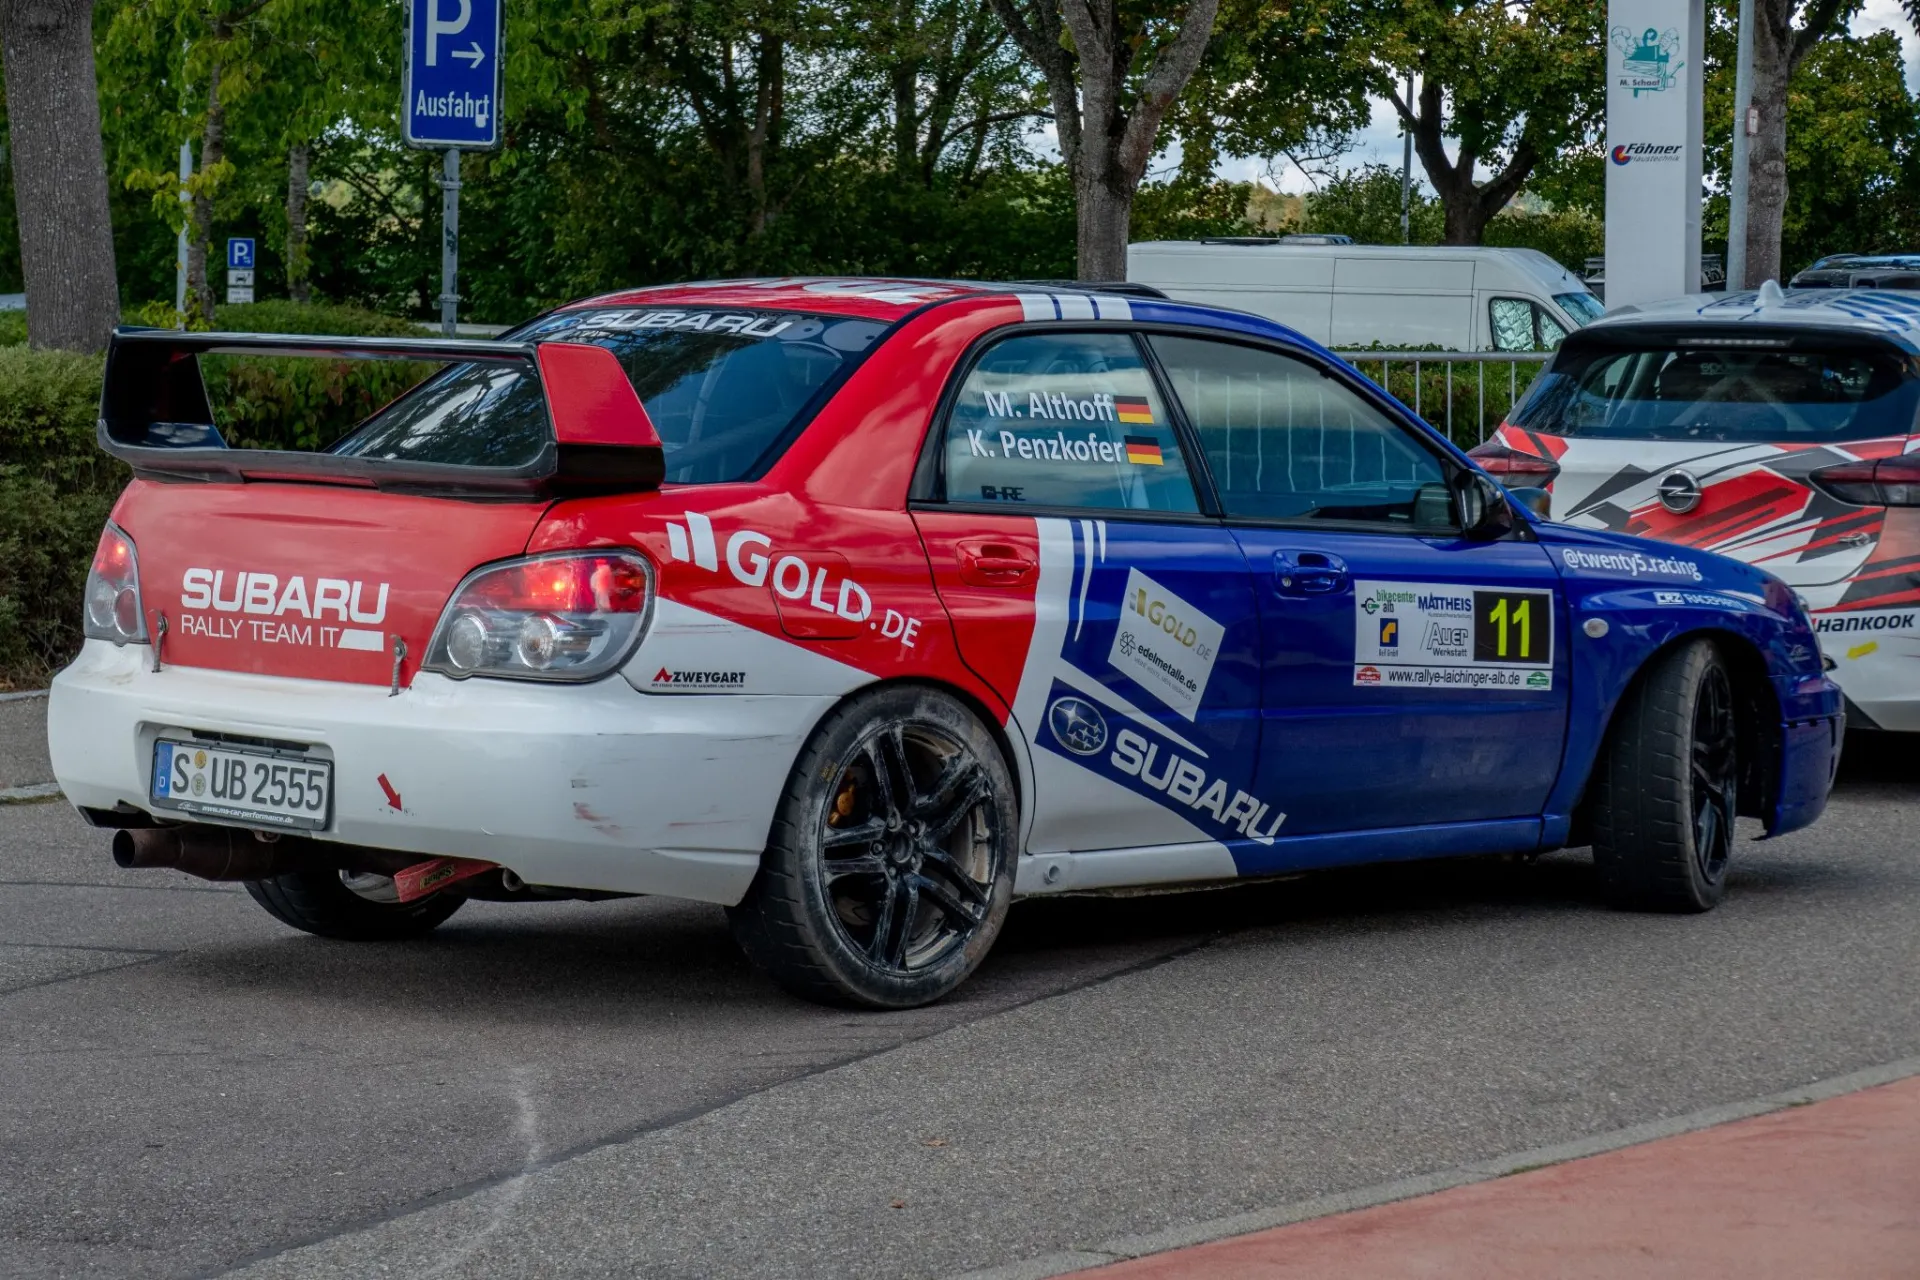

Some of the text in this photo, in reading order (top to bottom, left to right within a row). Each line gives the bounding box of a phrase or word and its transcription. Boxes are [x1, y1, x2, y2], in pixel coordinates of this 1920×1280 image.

[415, 89, 490, 119] Ausfahrt
[1625, 142, 1683, 155] Föhner
[577, 310, 794, 338] SUBARU
[983, 390, 1115, 422] M. Althoff
[966, 428, 1123, 463] K. Penzkofer
[1562, 548, 1703, 581] @twenty5.racing
[181, 567, 390, 625] SUBARU
[1376, 589, 1417, 603] bikecenter
[1382, 599, 1395, 613] alb
[1417, 592, 1473, 612] MATTHEIS
[180, 614, 340, 648] RALLY TEAM IT
[1489, 598, 1530, 658] 11
[1432, 647, 1468, 658] Werkstatt
[672, 671, 746, 684] ZWEYGART
[1137, 644, 1197, 693] edelmetalle.de
[1388, 669, 1520, 687] www.rallye-laichinger-alb.de
[171, 752, 191, 794] S
[210, 756, 248, 802] UB
[251, 762, 326, 812] 2555
[1110, 728, 1288, 846] SUBARU
